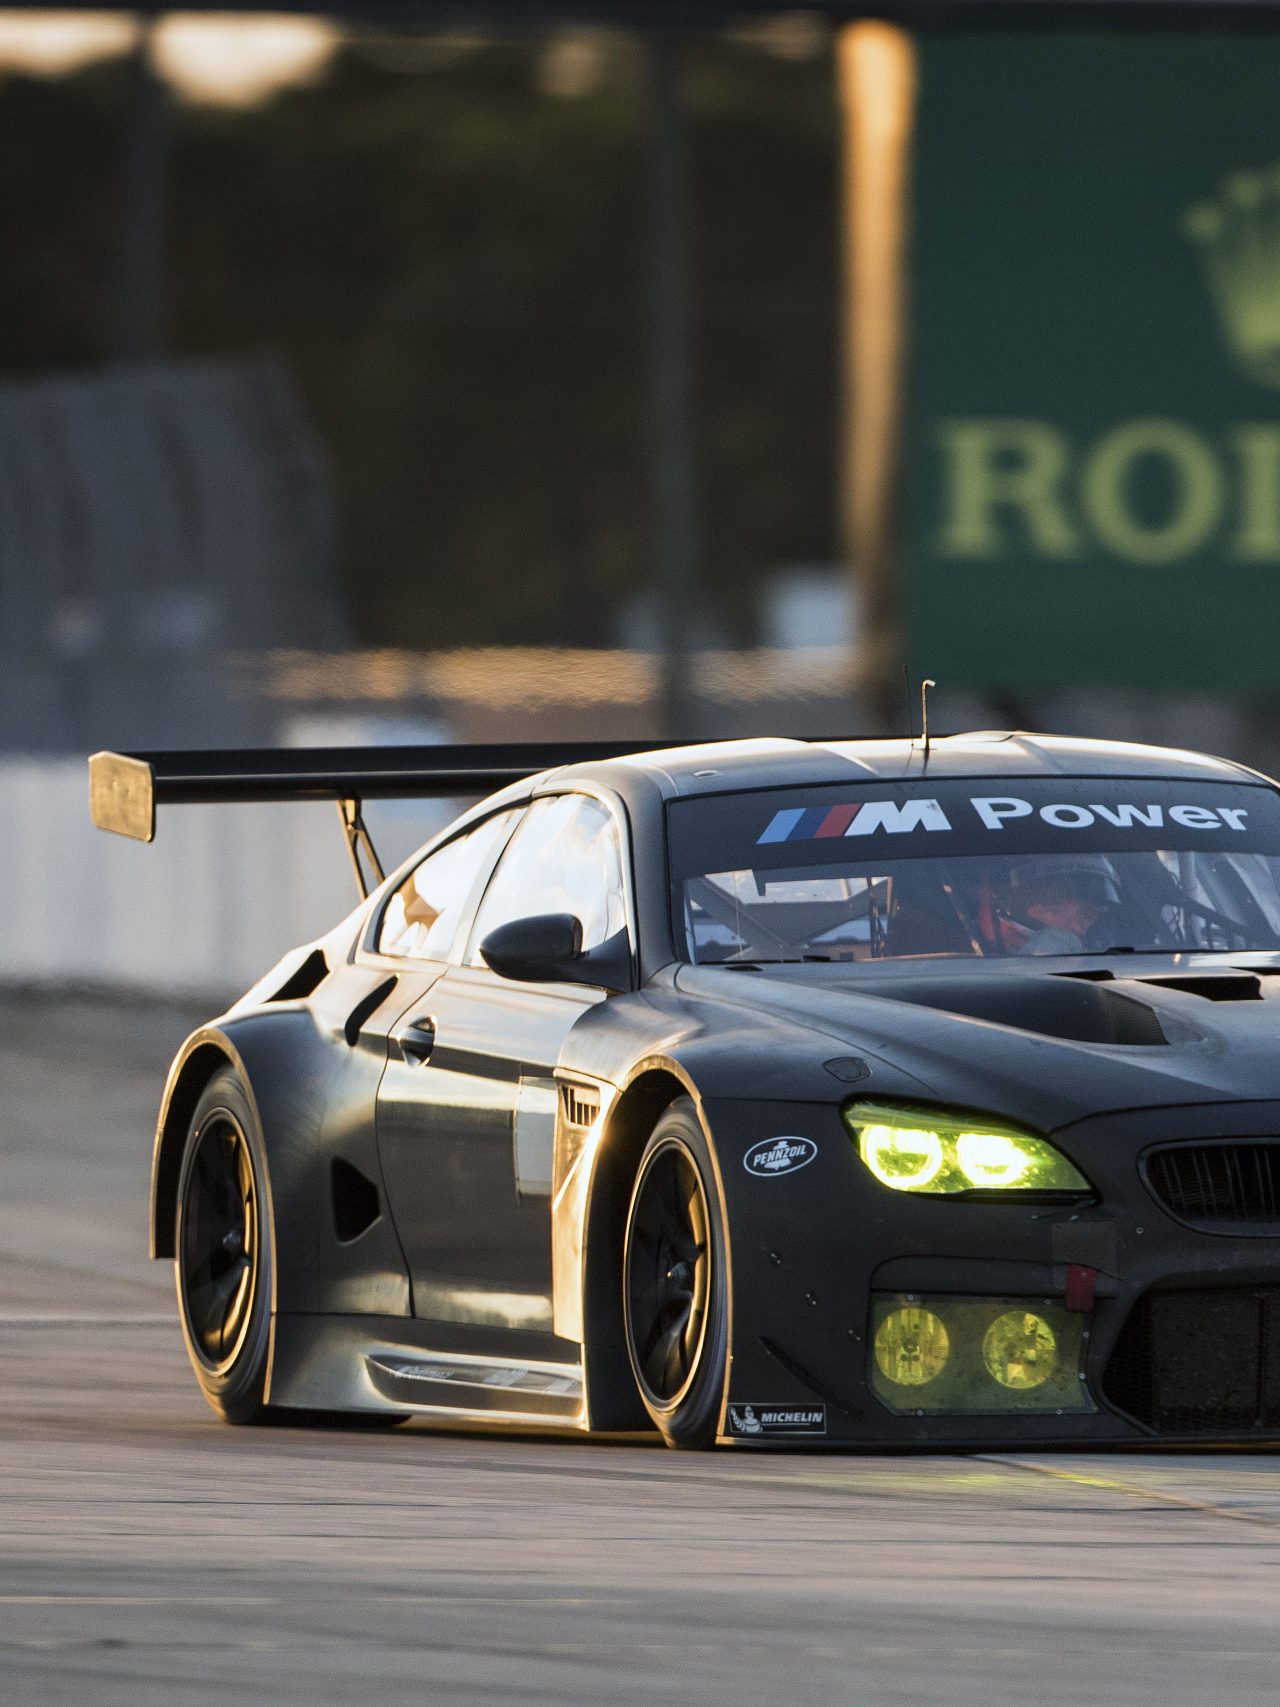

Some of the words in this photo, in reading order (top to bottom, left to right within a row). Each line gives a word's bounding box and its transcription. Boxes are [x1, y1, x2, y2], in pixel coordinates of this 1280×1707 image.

[970, 797, 1248, 831] Power
[753, 1144, 806, 1167] PENNZOIL
[761, 1412, 823, 1422] MICHELIN
